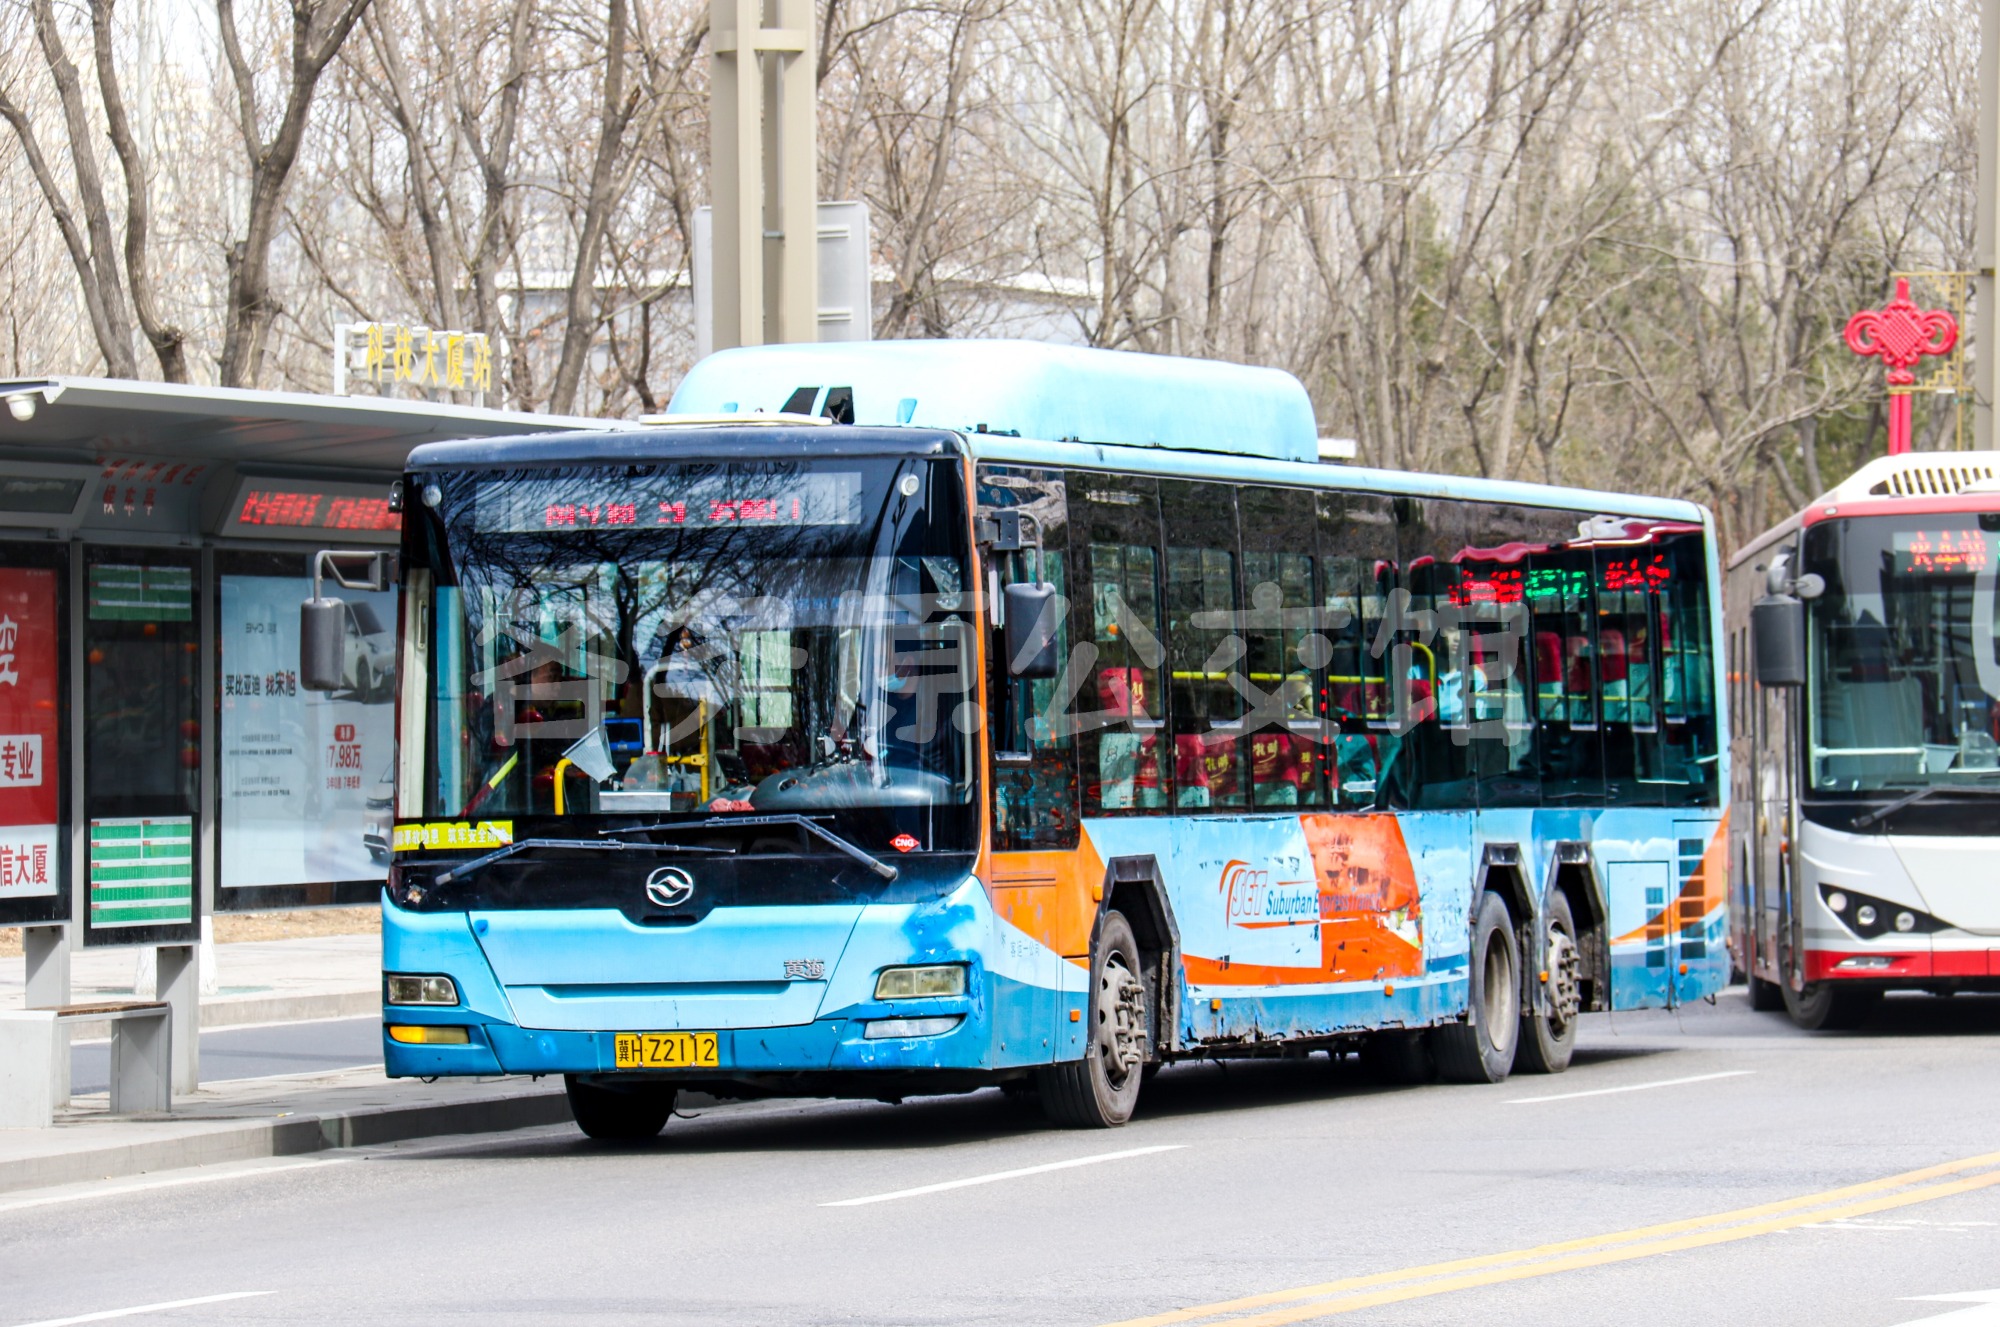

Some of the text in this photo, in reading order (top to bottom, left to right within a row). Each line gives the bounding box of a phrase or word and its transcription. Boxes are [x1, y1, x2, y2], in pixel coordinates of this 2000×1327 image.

[366, 324, 492, 392] 科技大厦站
[225, 674, 260, 696] 买比亚迪
[1, 741, 34, 780] 专业
[895, 838, 915, 848] CNG
[1265, 888, 1312, 916] Suburban
[784, 958, 825, 979] 黄海
